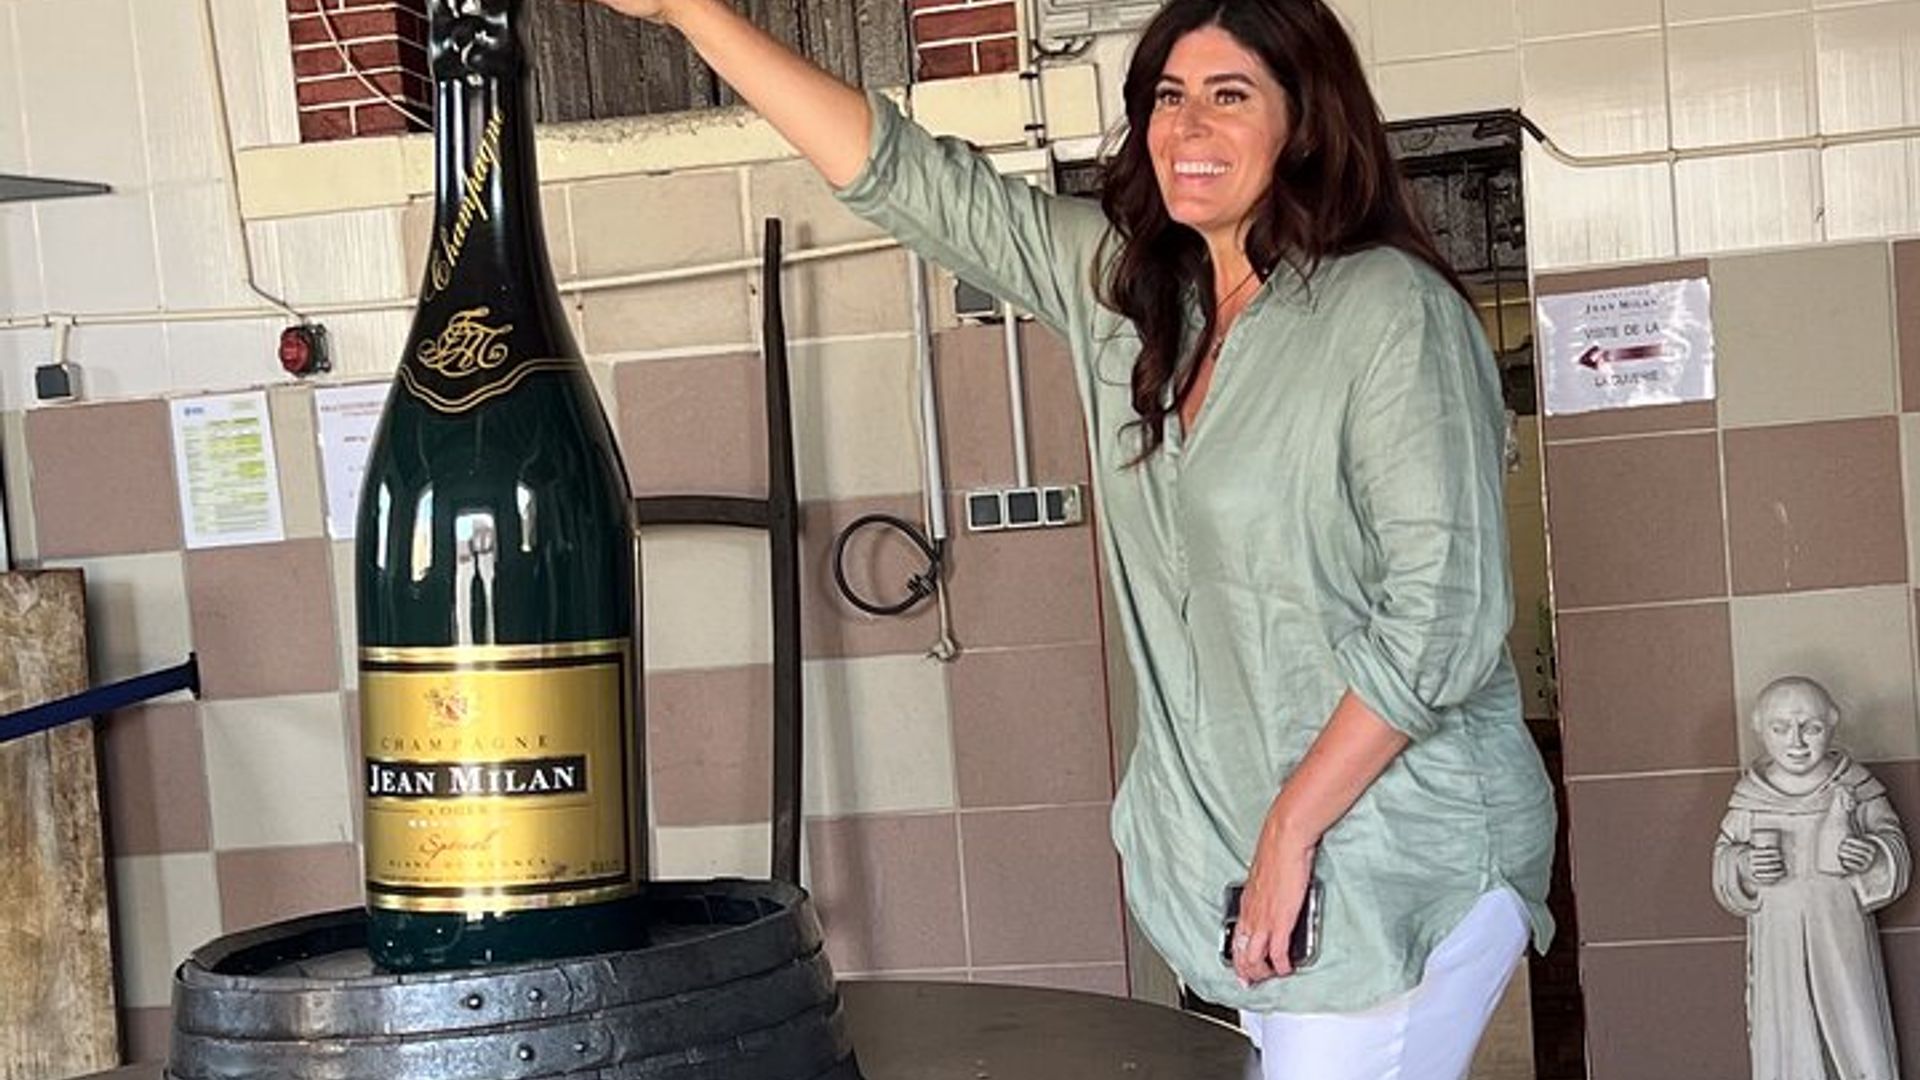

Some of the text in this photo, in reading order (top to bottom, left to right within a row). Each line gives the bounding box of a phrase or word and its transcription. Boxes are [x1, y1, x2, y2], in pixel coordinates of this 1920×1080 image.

[425, 111, 505, 300] Champagne
[1623, 324, 1641, 337] DE
[1645, 321, 1660, 335] LA
[380, 734, 549, 752] CHAMPAGNE
[369, 765, 575, 793] JEAN MILAN
